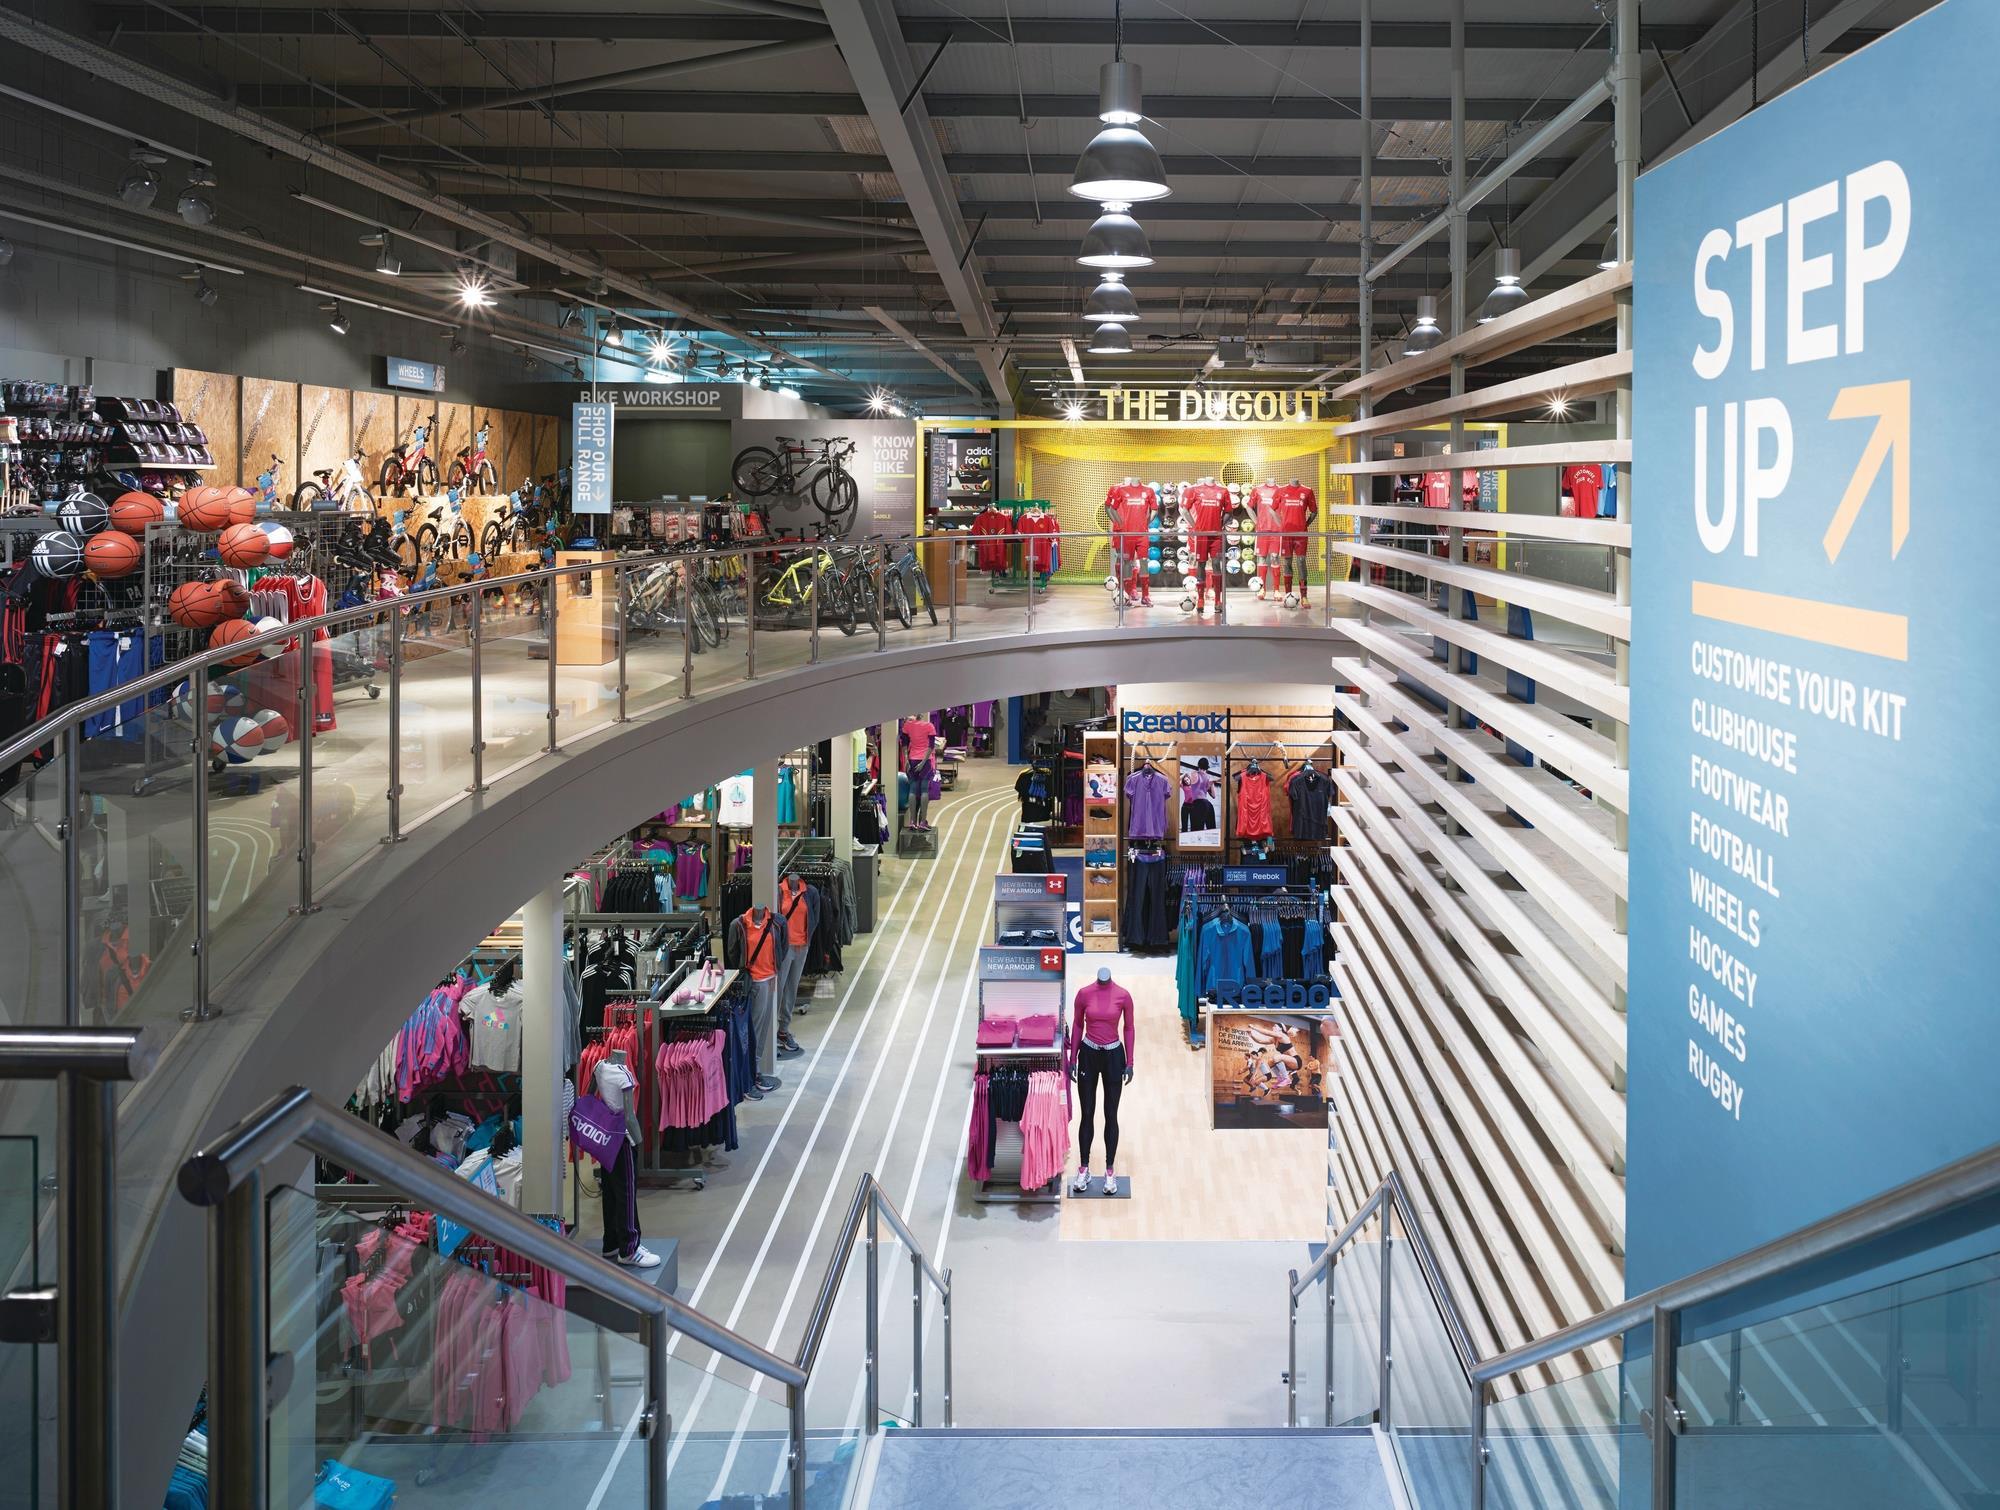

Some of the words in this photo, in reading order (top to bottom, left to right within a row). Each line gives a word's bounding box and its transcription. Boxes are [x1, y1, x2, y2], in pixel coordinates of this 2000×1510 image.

[1692, 159, 1912, 380] STEP
[398, 364, 425, 379] WHEELS
[623, 391, 721, 405] WORKSHOP
[1100, 389, 1169, 421] THE
[1180, 389, 1327, 421] DUGOUT
[578, 407, 591, 445] FULL
[592, 407, 605, 448] SHOP
[873, 436, 915, 448] KNOW
[592, 452, 605, 482] OUR
[873, 449, 909, 461] YOUR
[873, 462, 905, 473] BIKE
[966, 447, 992, 456] adida
[578, 449, 591, 502] RANGE
[1482, 470, 1492, 503] RANGE
[1693, 396, 1794, 558] UP
[1691, 640, 1792, 706] CUSTOMISE
[1795, 667, 1857, 728] YOUR
[1863, 685, 1907, 741] KIT
[1124, 711, 1227, 733] Reebok
[1691, 697, 1798, 775] CLUBHOUSE
[1691, 754, 1790, 838] FOOTWEAR
[1690, 810, 1780, 898] FOOTBALL
[1689, 867, 1761, 948] WHEELS
[1689, 924, 1758, 1008] HOCKEY
[1217, 979, 1341, 1009] Reebo
[1688, 983, 1747, 1063] GAMES
[1688, 1038, 1744, 1121] RUGBY
[571, 1115, 611, 1146] ADIDAS
